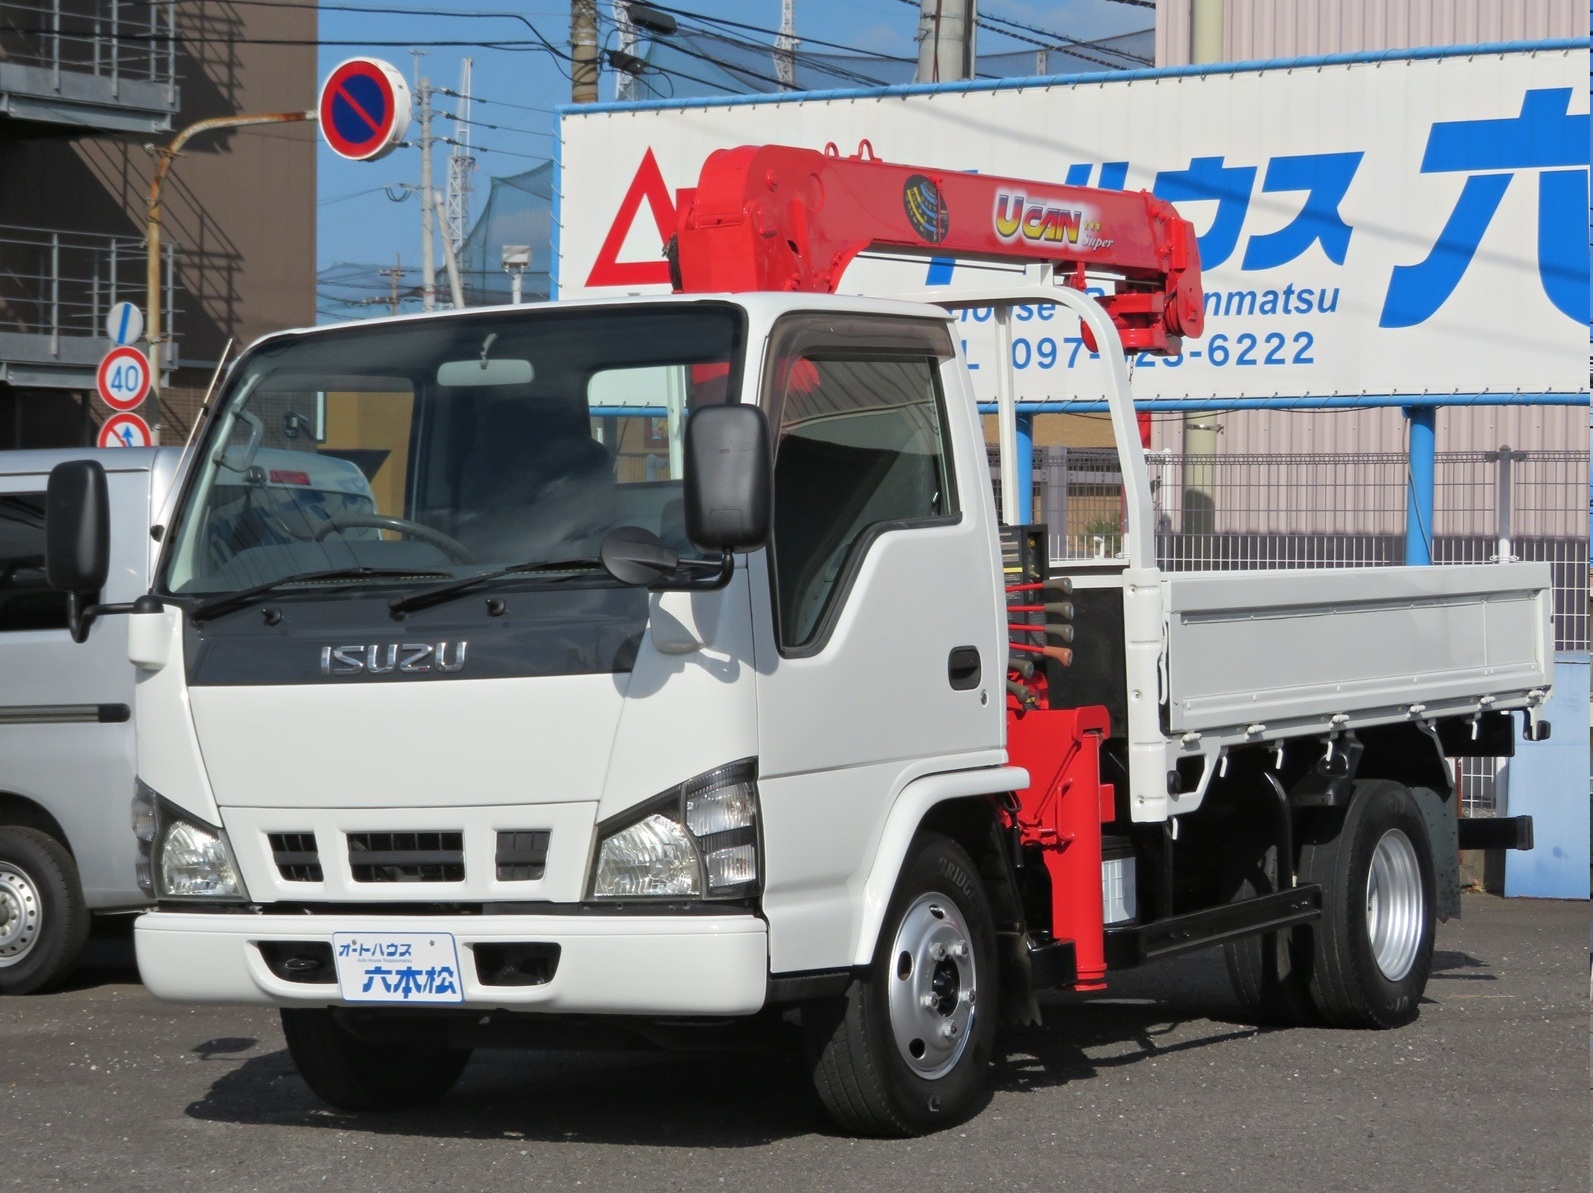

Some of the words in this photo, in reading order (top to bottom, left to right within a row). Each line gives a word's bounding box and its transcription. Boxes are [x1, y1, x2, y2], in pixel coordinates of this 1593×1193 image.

[1082, 234, 1114, 251] Super
[1012, 331, 1314, 370] 097--6222
[110, 365, 139, 392] 40
[321, 641, 467, 675] ISUZU
[338, 943, 413, 957] オートハウス
[362, 966, 456, 999] 六本松
